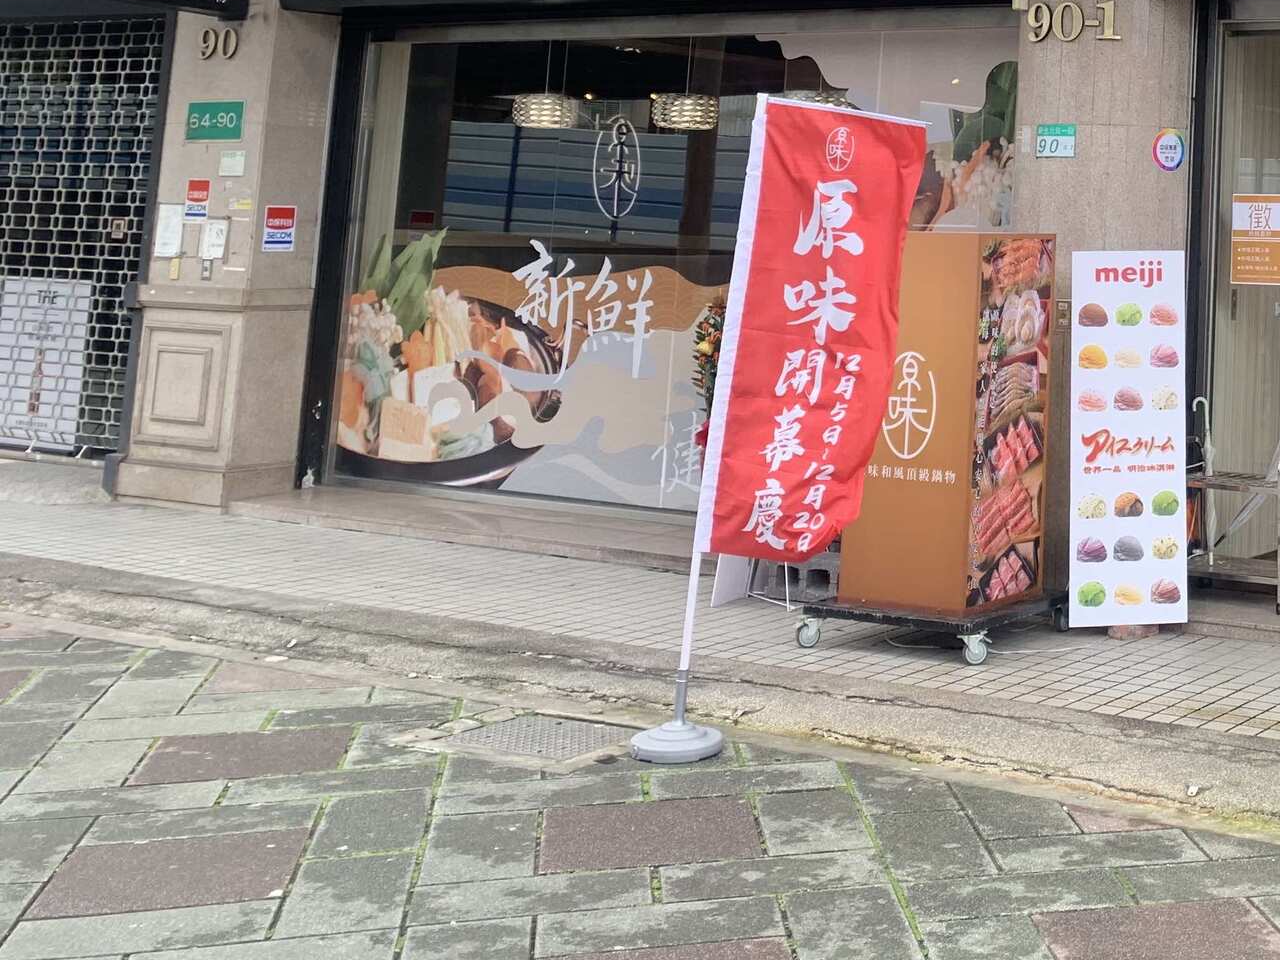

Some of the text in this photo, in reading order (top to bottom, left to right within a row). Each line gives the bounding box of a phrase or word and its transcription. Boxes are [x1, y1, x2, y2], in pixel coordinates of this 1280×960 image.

[1027, 0, 1122, 43] 90-1
[199, 27, 239, 60] 90
[189, 111, 237, 129] 64-90
[1038, 138, 1059, 154] 90
[187, 203, 207, 212] SECOM
[1248, 203, 1272, 230] 徵
[266, 231, 292, 240] SECOM
[1095, 260, 1164, 288] meiji
[512, 239, 656, 384] 新鮮
[1081, 428, 1175, 462] アイスクリーム
[863, 464, 956, 484] 味和風頂級鍋物
